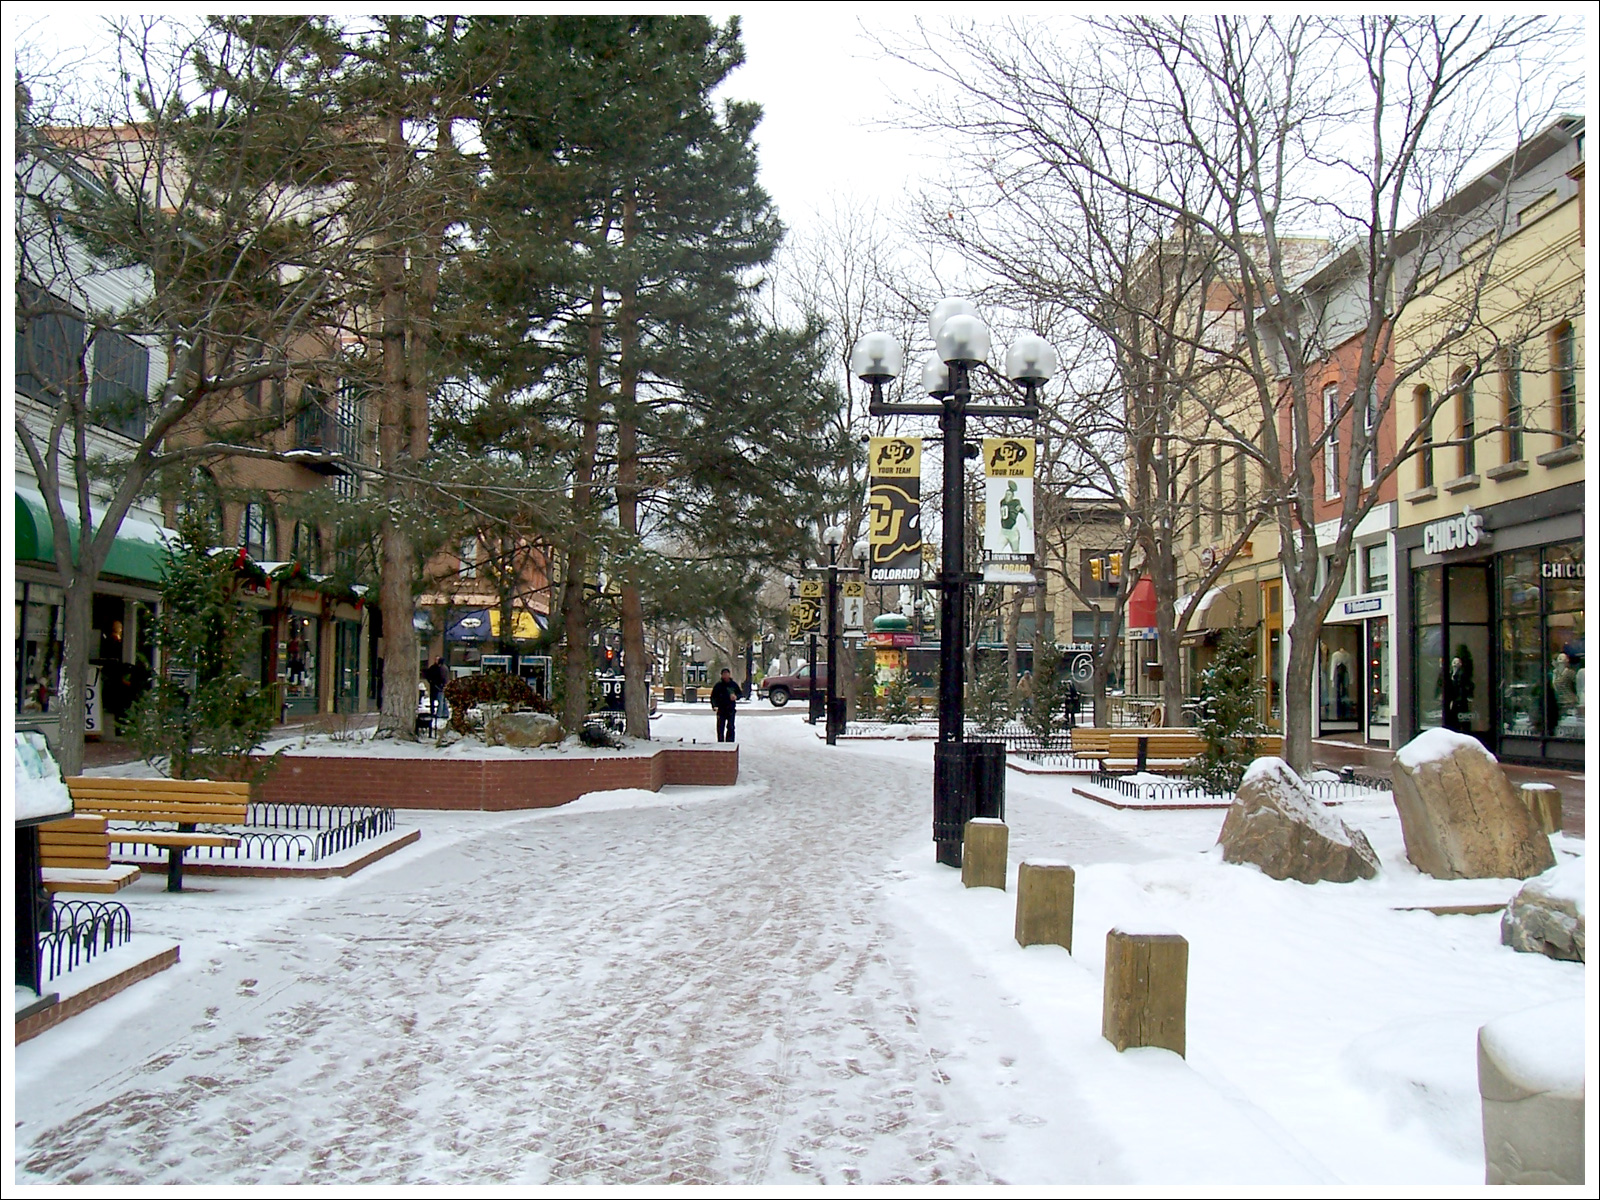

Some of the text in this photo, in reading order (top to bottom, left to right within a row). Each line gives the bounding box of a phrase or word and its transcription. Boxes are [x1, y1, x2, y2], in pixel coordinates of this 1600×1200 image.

[1424, 504, 1481, 554] CHICO'S
[871, 568, 920, 581] COLORADO
[1542, 563, 1585, 578] CHICO
[1071, 653, 1095, 683] 6
